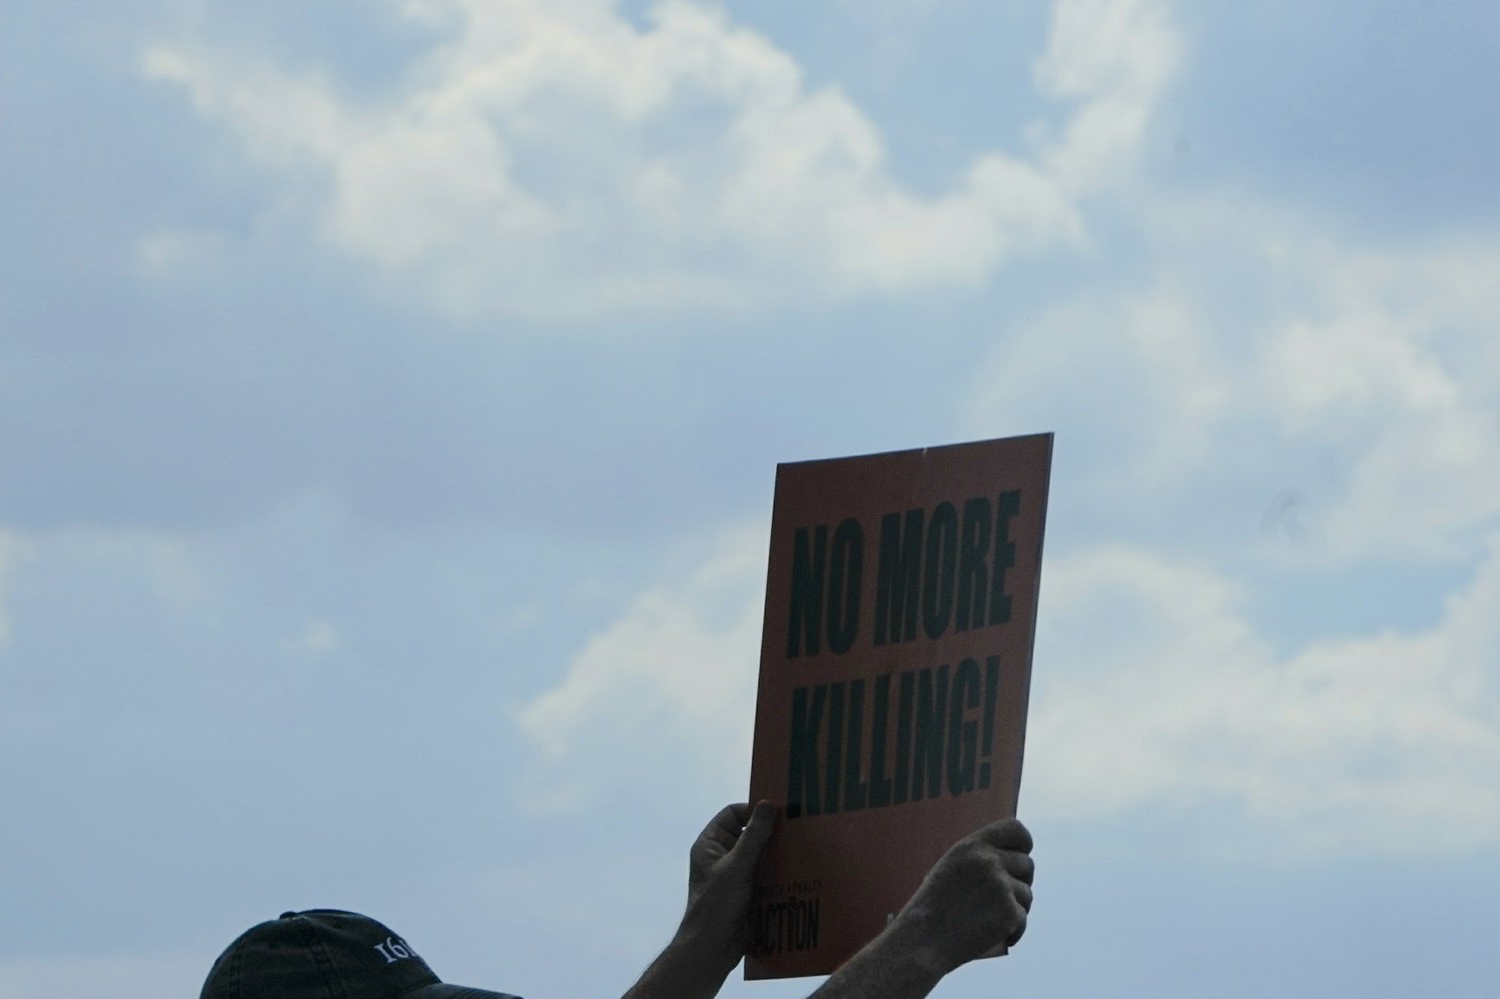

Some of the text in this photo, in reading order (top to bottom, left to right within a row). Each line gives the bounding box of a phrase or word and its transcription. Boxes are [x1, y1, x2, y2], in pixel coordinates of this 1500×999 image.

[786, 489, 1022, 660] NO MORE
[786, 655, 1000, 820] KILLING!
